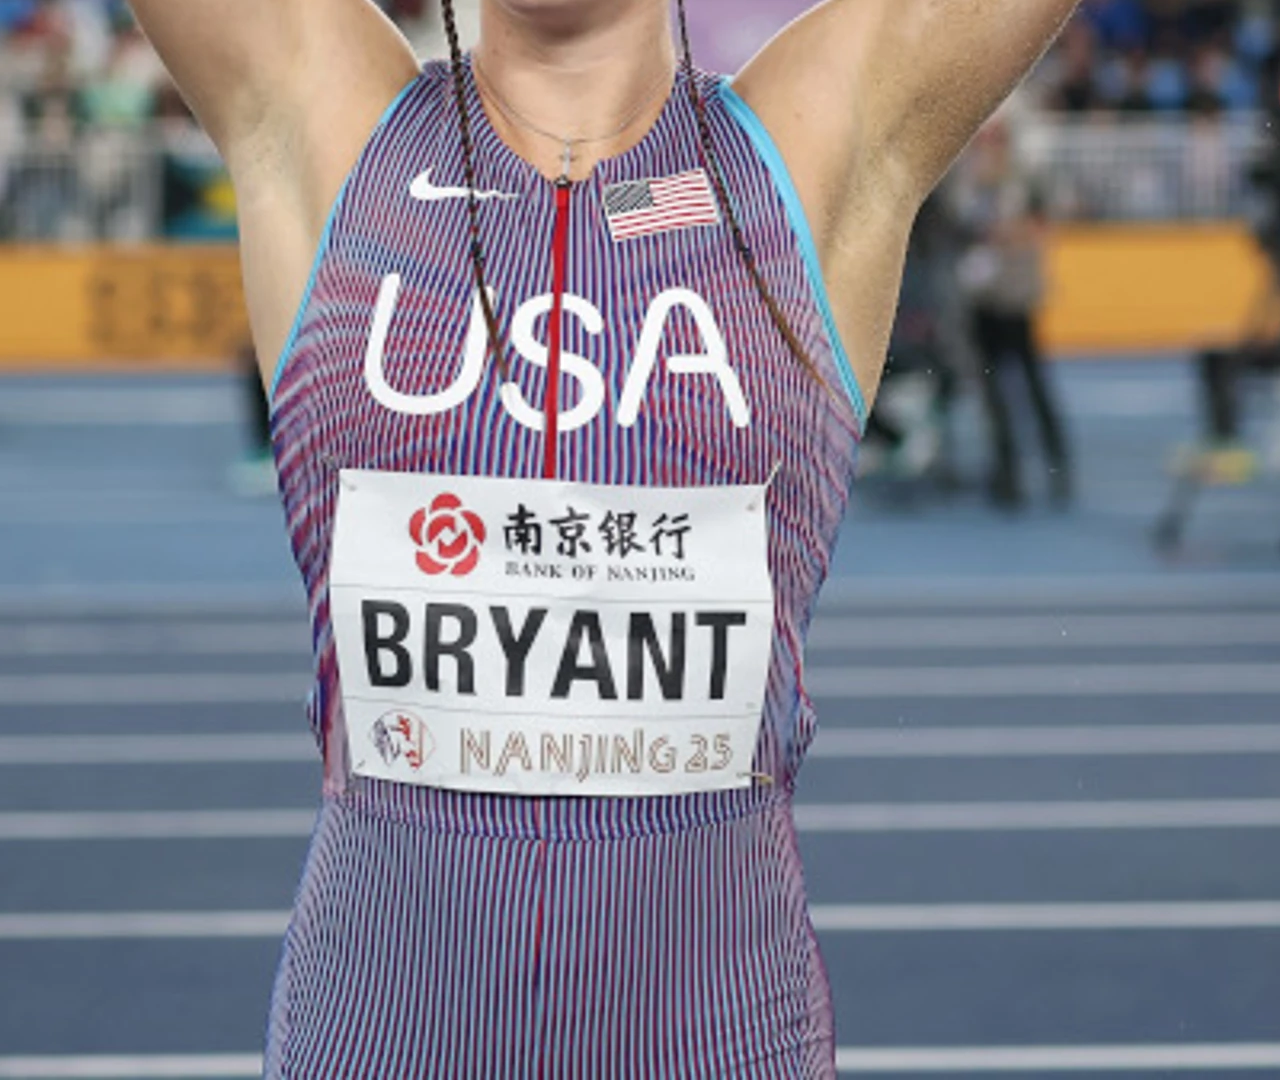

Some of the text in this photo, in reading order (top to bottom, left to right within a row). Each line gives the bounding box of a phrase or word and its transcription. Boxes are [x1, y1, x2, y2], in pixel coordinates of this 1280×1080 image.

[363, 272, 750, 432] USA
[503, 503, 692, 560] 南京银行
[505, 561, 696, 585] BANK OF NANJING
[361, 599, 748, 702] BRYANT
[460, 727, 734, 783] NANJING 25
